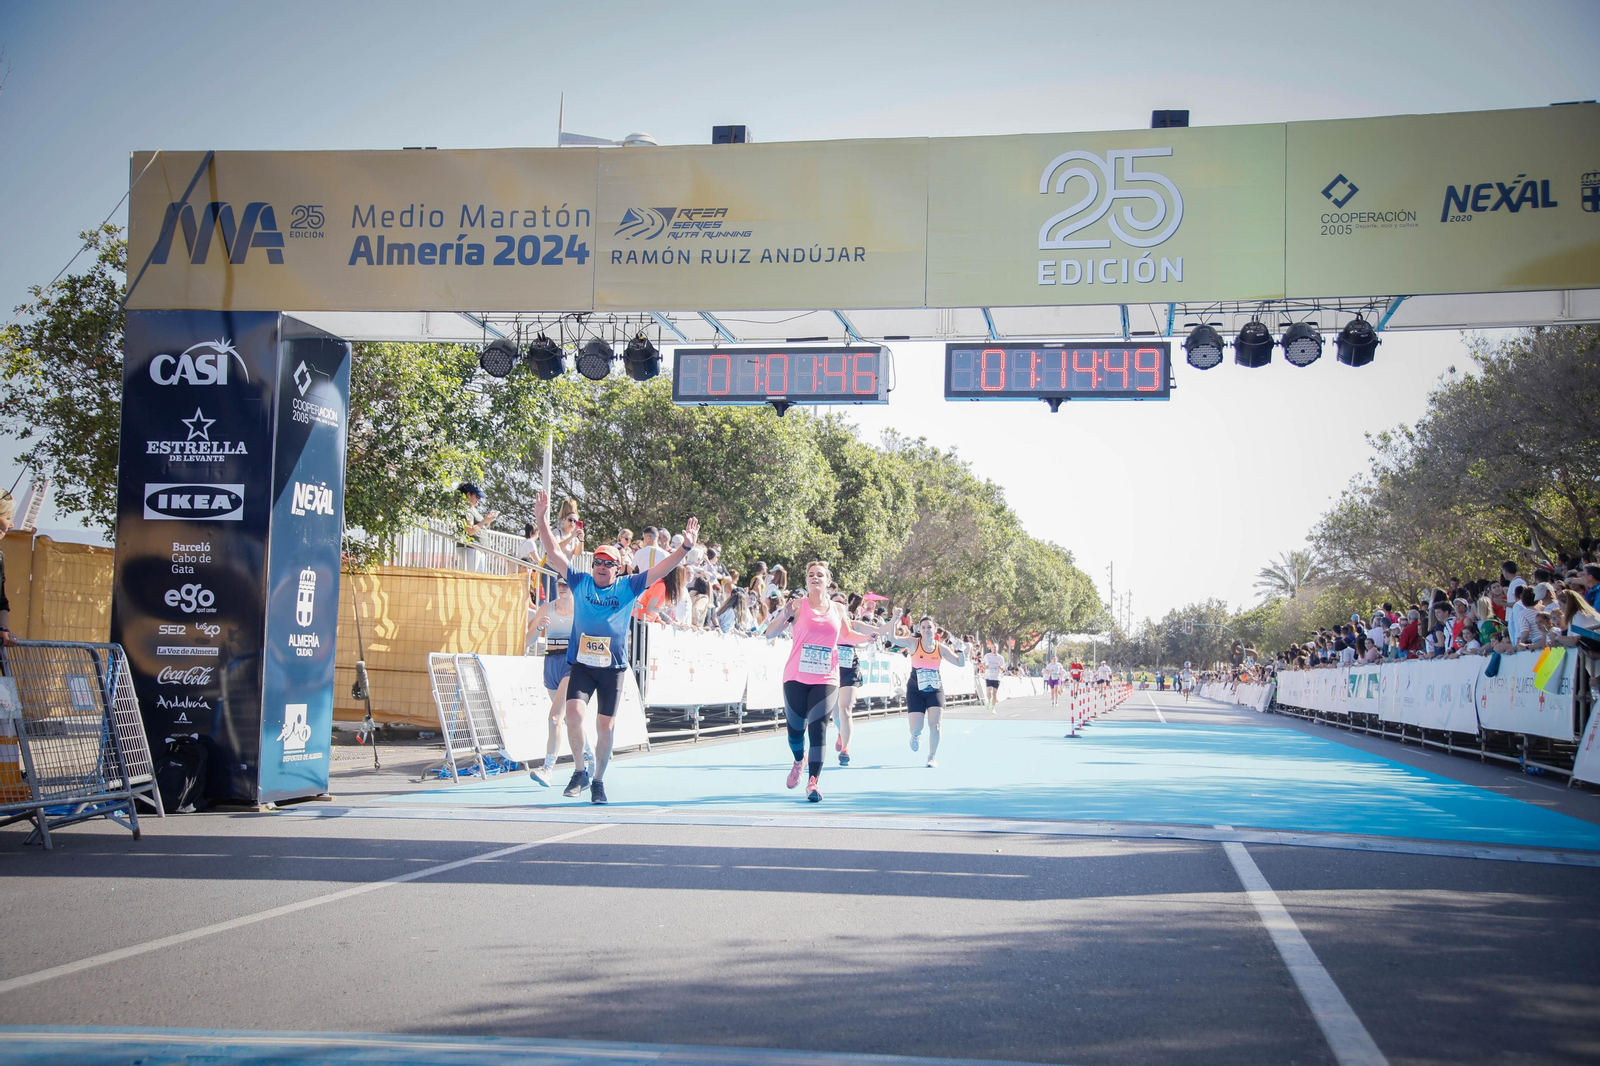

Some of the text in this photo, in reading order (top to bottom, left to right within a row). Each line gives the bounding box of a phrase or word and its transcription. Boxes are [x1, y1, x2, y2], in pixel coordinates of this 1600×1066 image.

[1038, 147, 1184, 250] 25
[290, 204, 325, 229] 25
[352, 203, 590, 228] Medio Maratón
[677, 208, 728, 220] RFEA
[1320, 209, 1417, 224] COOPERACIÓN
[1450, 214, 1472, 222] 2020
[672, 221, 723, 230] SERIES
[1320, 224, 1352, 236] 2005
[290, 229, 324, 238] EDICIÓN
[667, 231, 752, 240] RUTA RUNNING
[348, 234, 590, 266] Almería 2024
[611, 244, 867, 264] RAMÓN RUIZ ANDÚJAR
[1037, 252, 1184, 285] EDICIÓN
[150, 354, 228, 385] CASI
[980, 348, 1160, 391] 01:14:49
[292, 398, 338, 422] COOPERACIÓN
[292, 410, 309, 424] 2005
[146, 441, 248, 455] ESTRELLA
[158, 494, 232, 509] IKEA
[172, 542, 210, 552] Barceló
[172, 554, 211, 563] Cabo de
[171, 564, 194, 574] Gata
[164, 583, 214, 613] ego
[204, 625, 220, 637] 40
[288, 632, 320, 648] ALMERÍA
[586, 641, 604, 651] 464
[296, 648, 313, 657] CIUDAD
[157, 666, 215, 686] Coca-Cola
[156, 695, 211, 710] Andalucía
